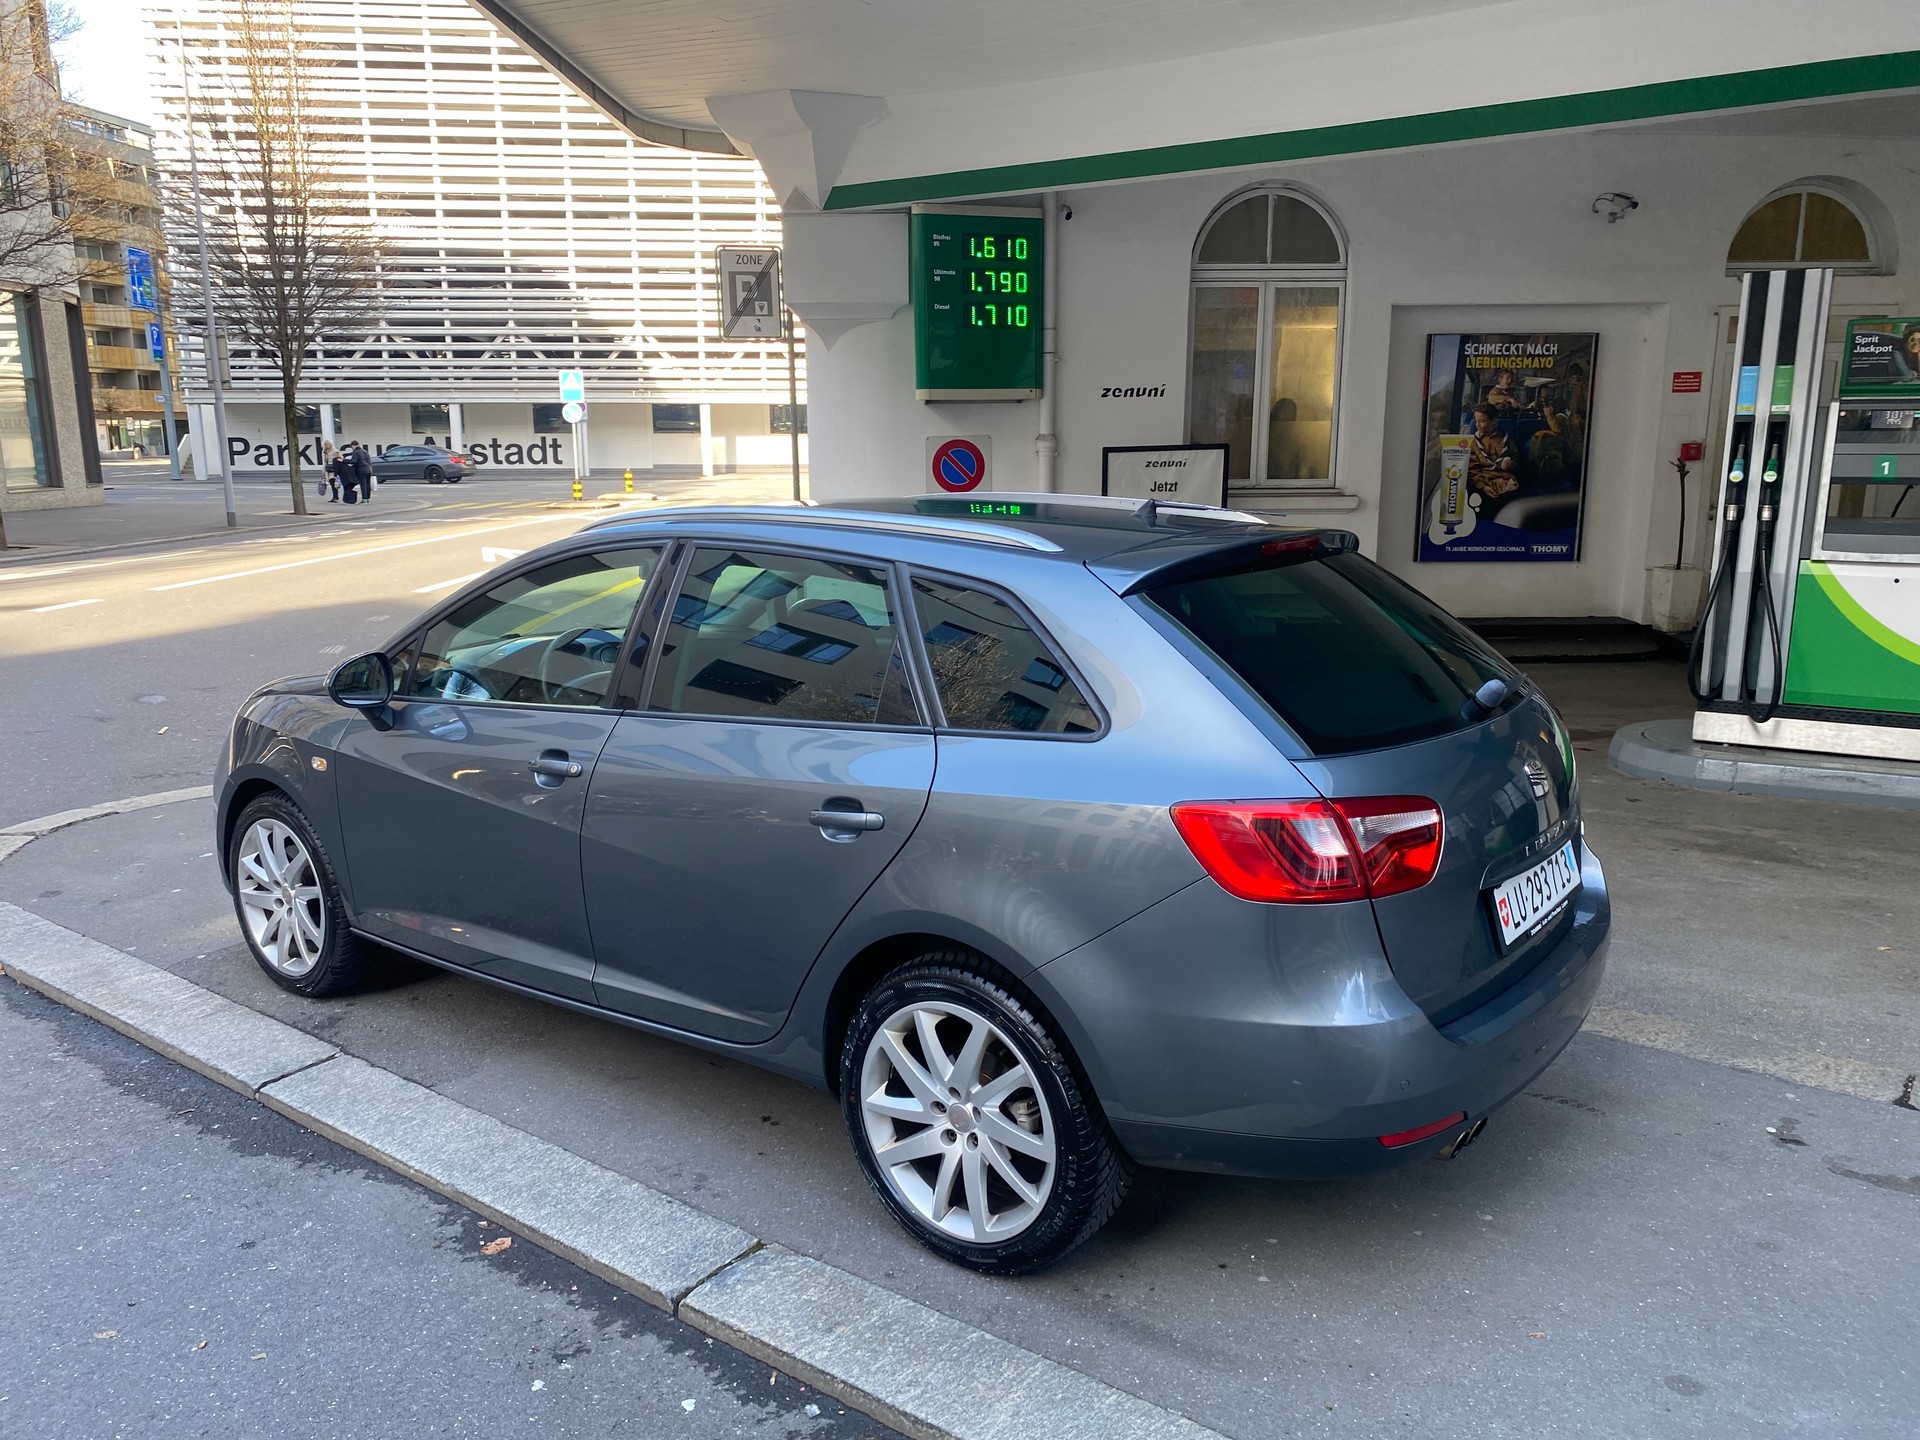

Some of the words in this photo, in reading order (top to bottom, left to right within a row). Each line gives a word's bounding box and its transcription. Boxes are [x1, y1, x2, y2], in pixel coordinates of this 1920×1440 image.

[970, 237, 1027, 259] 1.610
[736, 254, 763, 265] ZONE
[971, 271, 1027, 293] 1.790
[971, 305, 1027, 327] 1.710
[1855, 335, 1880, 345] Sprit
[1464, 343, 1524, 355] SCHMECKT
[1526, 343, 1558, 355] NACH
[1853, 344, 1893, 354] Jackpot
[1465, 356, 1554, 369] LIEBLINGSMAYO
[1101, 384, 1166, 398] zenuni
[1145, 458, 1188, 468] zenuni
[1881, 461, 1890, 475] 1
[1150, 481, 1178, 492] Jetzt
[1449, 479, 1458, 512] THOMY
[1532, 545, 1569, 553] THOMY
[1066, 1154, 1078, 1189] STAR
